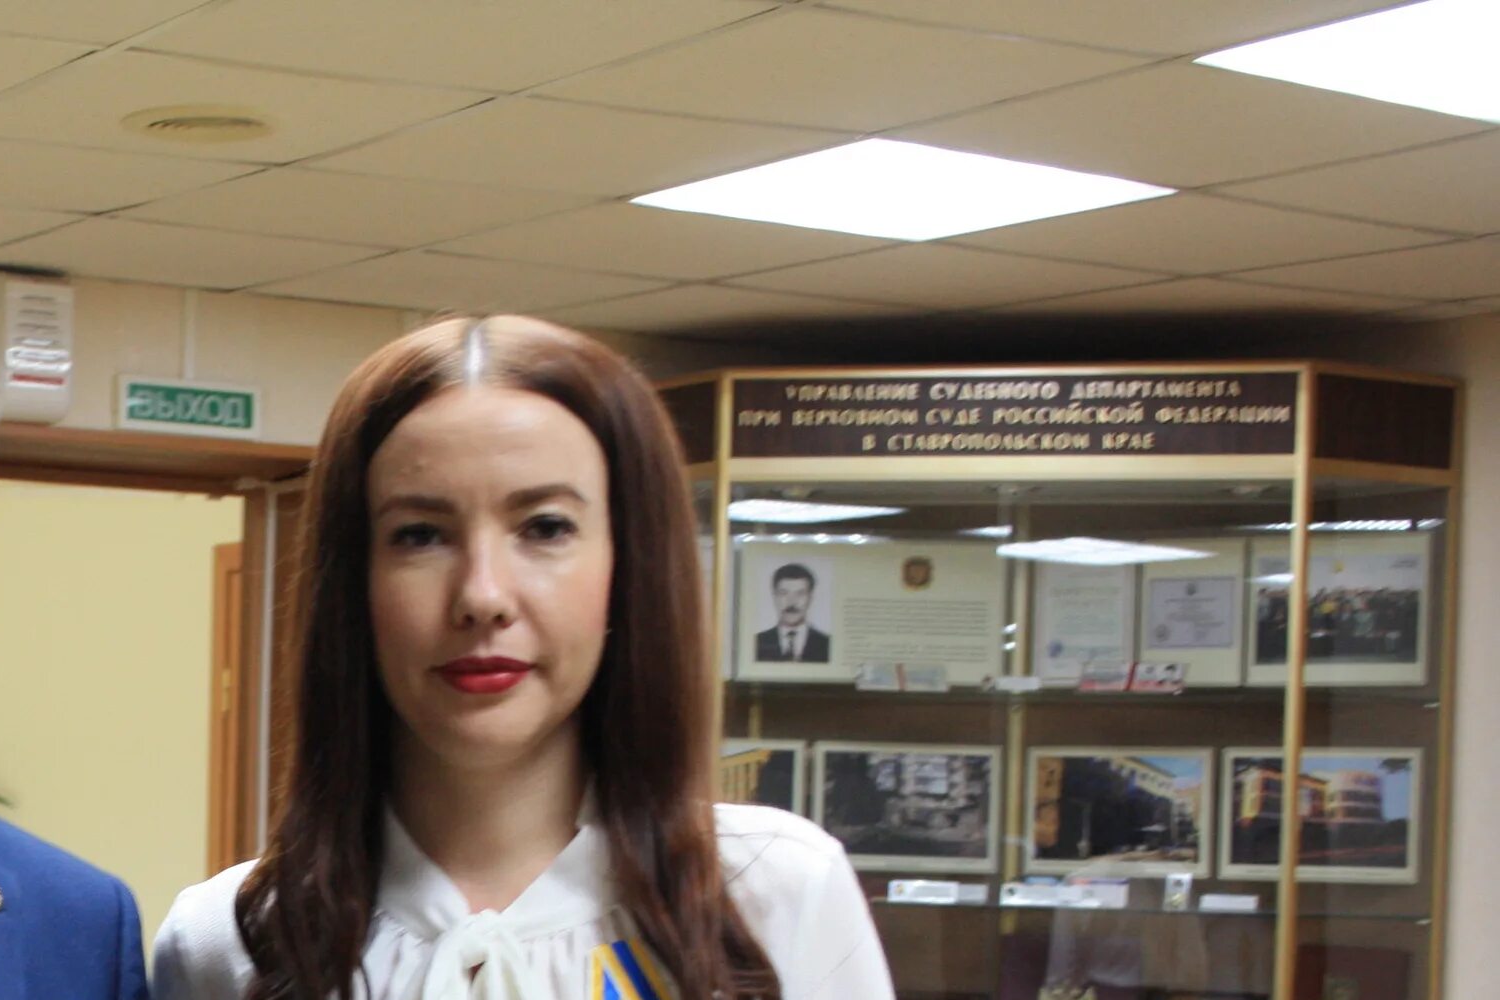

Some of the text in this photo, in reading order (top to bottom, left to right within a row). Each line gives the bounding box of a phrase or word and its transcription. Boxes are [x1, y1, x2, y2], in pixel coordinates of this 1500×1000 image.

[785, 380, 1242, 401] УПРАВЛЕНИЕ СУДЕБНОГО ДЕПАРТАМЕНТА
[132, 389, 246, 426] ВЫХОД
[738, 401, 1291, 427] ПРИ ВЕРХОВНОМ СУДЕ РОССИЙСКОЙ ФЕДЕРАЦИИ
[887, 432, 1090, 451] СТАВРОПОЛЬСКОМ
[1102, 431, 1155, 450] КРАЕ
